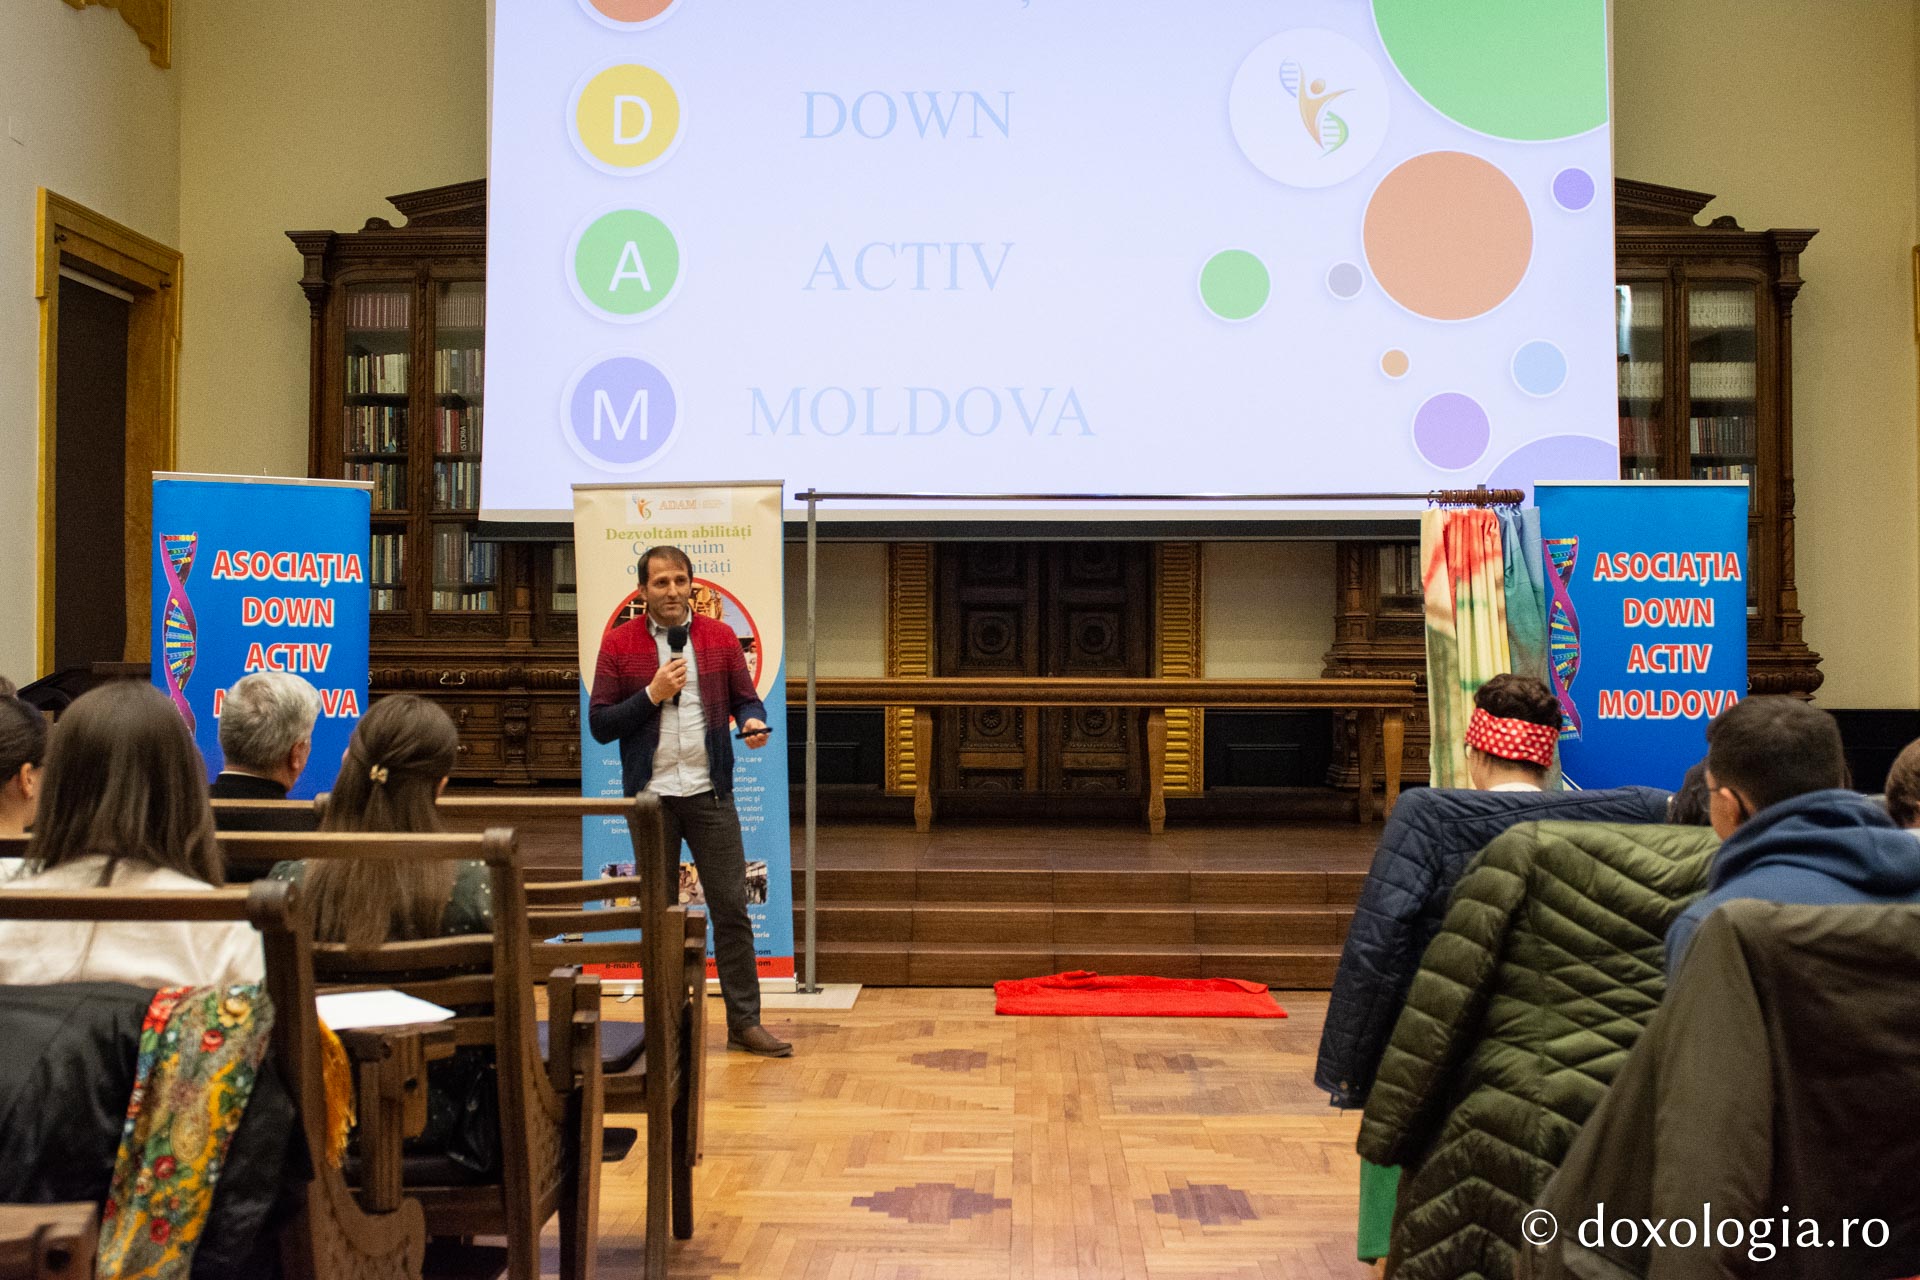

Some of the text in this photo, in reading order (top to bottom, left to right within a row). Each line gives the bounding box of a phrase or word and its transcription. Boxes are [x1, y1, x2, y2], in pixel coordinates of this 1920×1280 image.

[613, 90, 1015, 146] D DOWN
[608, 240, 1016, 292] A ACTIV
[592, 386, 1097, 441] M MOLDOVA
[660, 499, 697, 511] ADAM
[605, 524, 752, 541] Dezvoltăm abilități
[211, 550, 363, 588] ASOCIAȚIA
[1593, 551, 1742, 587] ASOCIAȚIA
[242, 597, 335, 628] DOWN
[1623, 598, 1715, 628] DOWN
[244, 642, 332, 673] ACTIV
[1626, 643, 1713, 674] ACTIV
[1598, 689, 1740, 720] MOLDOVA
